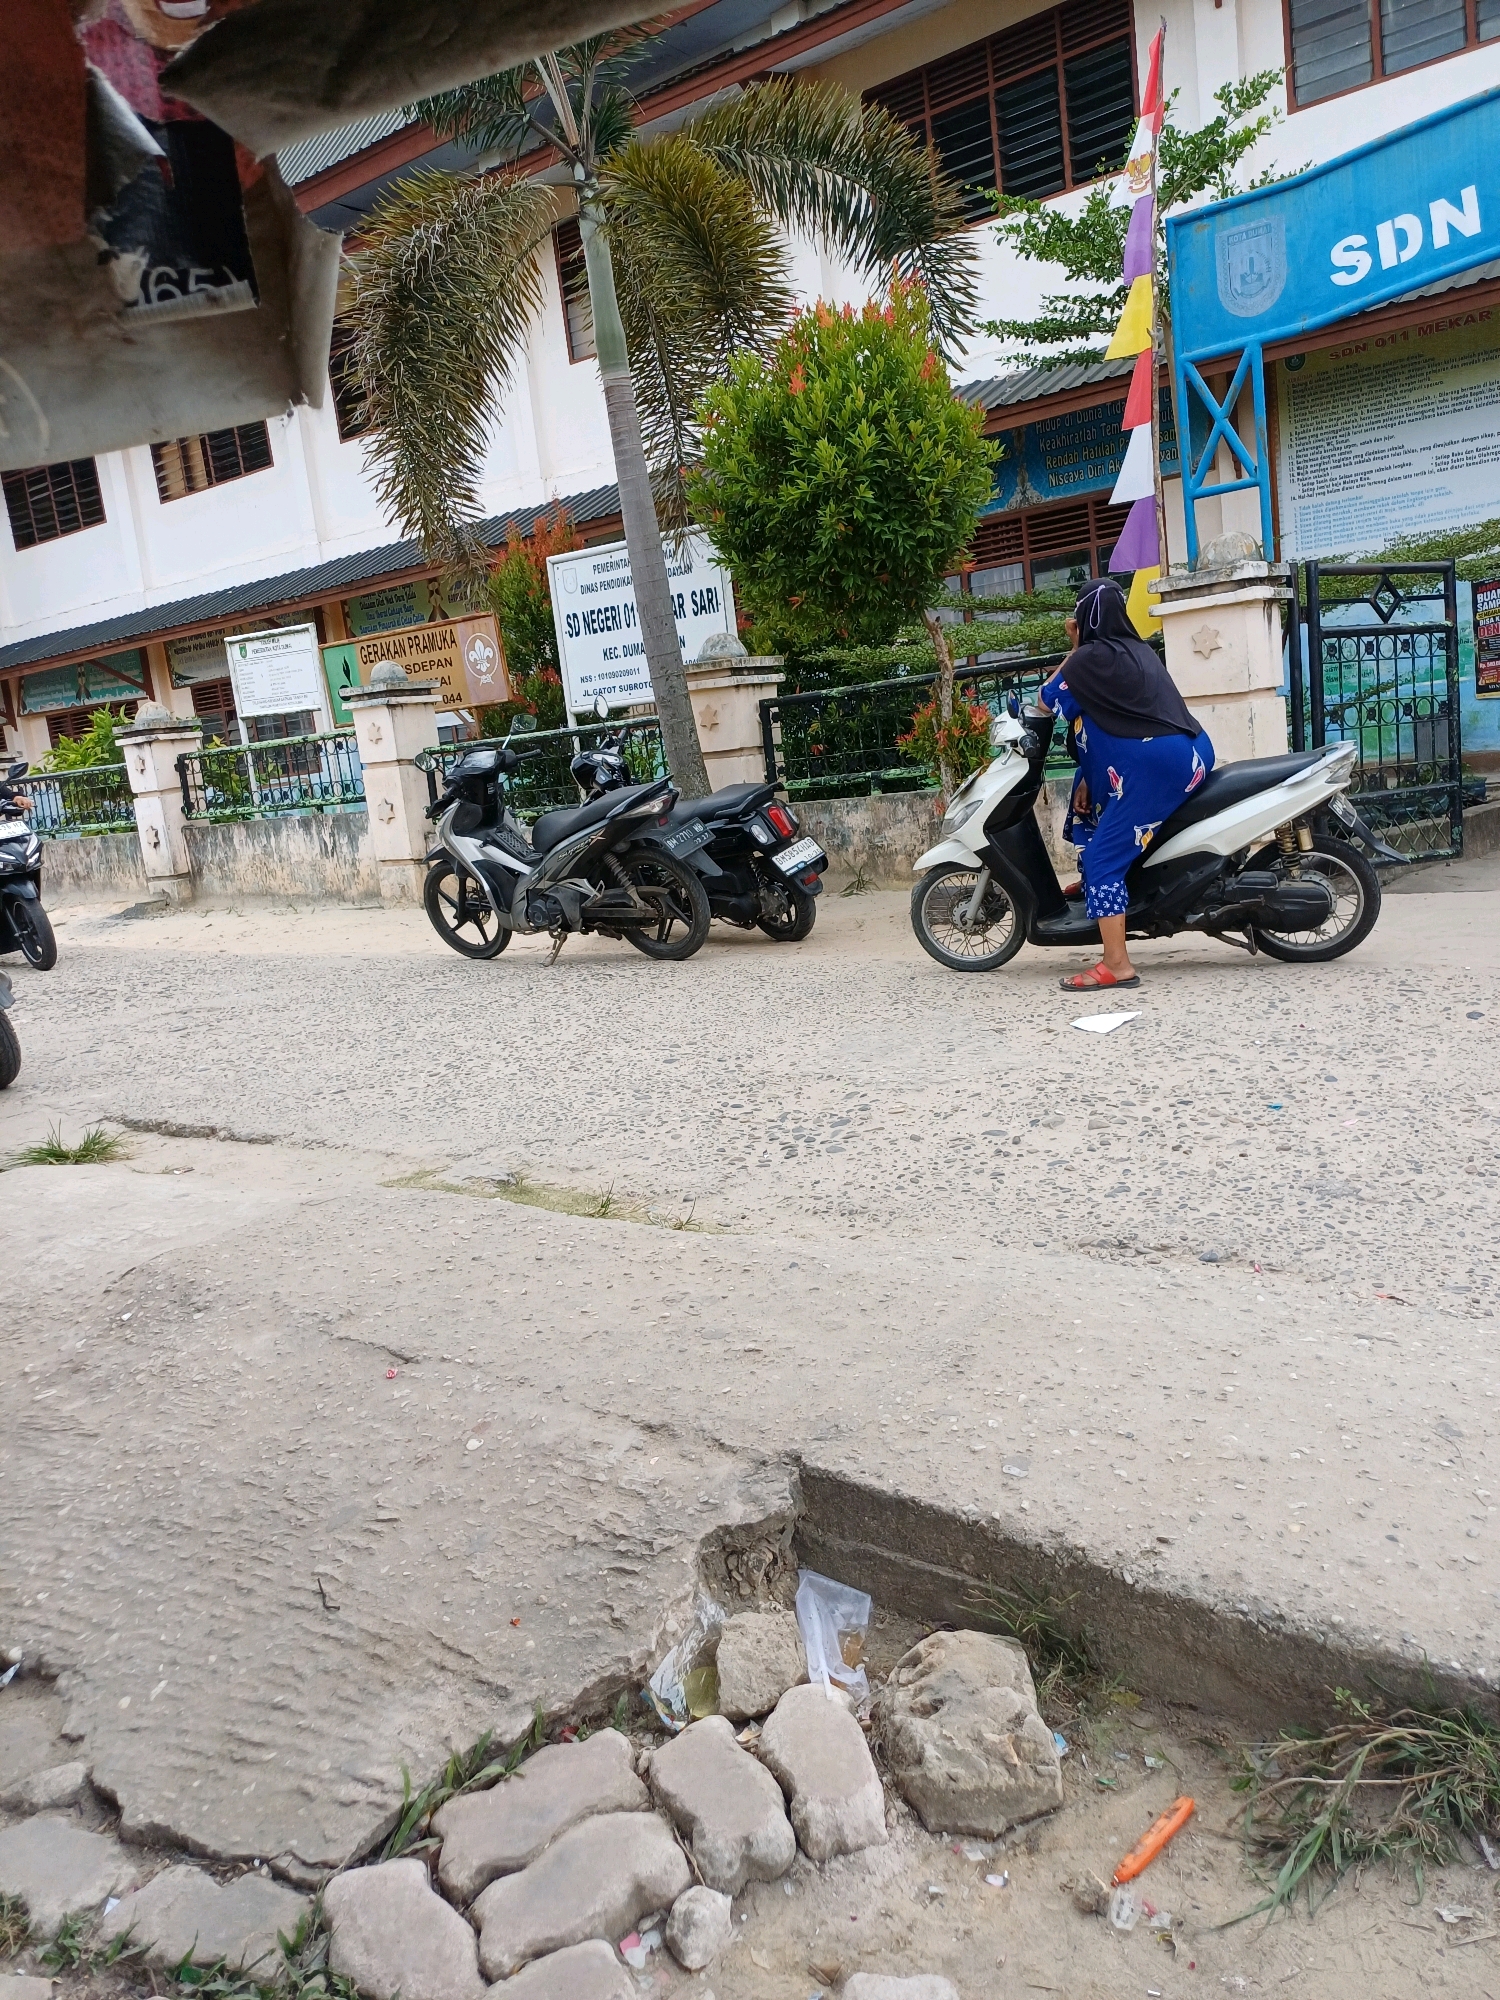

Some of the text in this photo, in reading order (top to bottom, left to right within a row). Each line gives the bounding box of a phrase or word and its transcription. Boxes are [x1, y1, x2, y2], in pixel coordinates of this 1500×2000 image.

[1228, 225, 1270, 245] KOTA DUMAI
[1330, 185, 1481, 286] SDN
[1329, 310, 1492, 360] SDN 011 MEKAR
[1064, 413, 1073, 427] di
[1076, 407, 1103, 424] Dunia
[1105, 400, 1126, 417] Tida
[1046, 447, 1079, 470] Rendah
[1082, 440, 1116, 460] Hatilah
[1048, 469, 1085, 488] Niscaya
[1087, 461, 1105, 479] Diri
[580, 581, 599, 595] DINAS
[566, 612, 581, 638] SD
[582, 604, 622, 636] NEGERI
[623, 601, 637, 629] 01
[691, 586, 720, 617] SARI
[360, 628, 458, 665] GERAKAN PRAMUKA
[602, 642, 646, 661] KEC. DUMA
